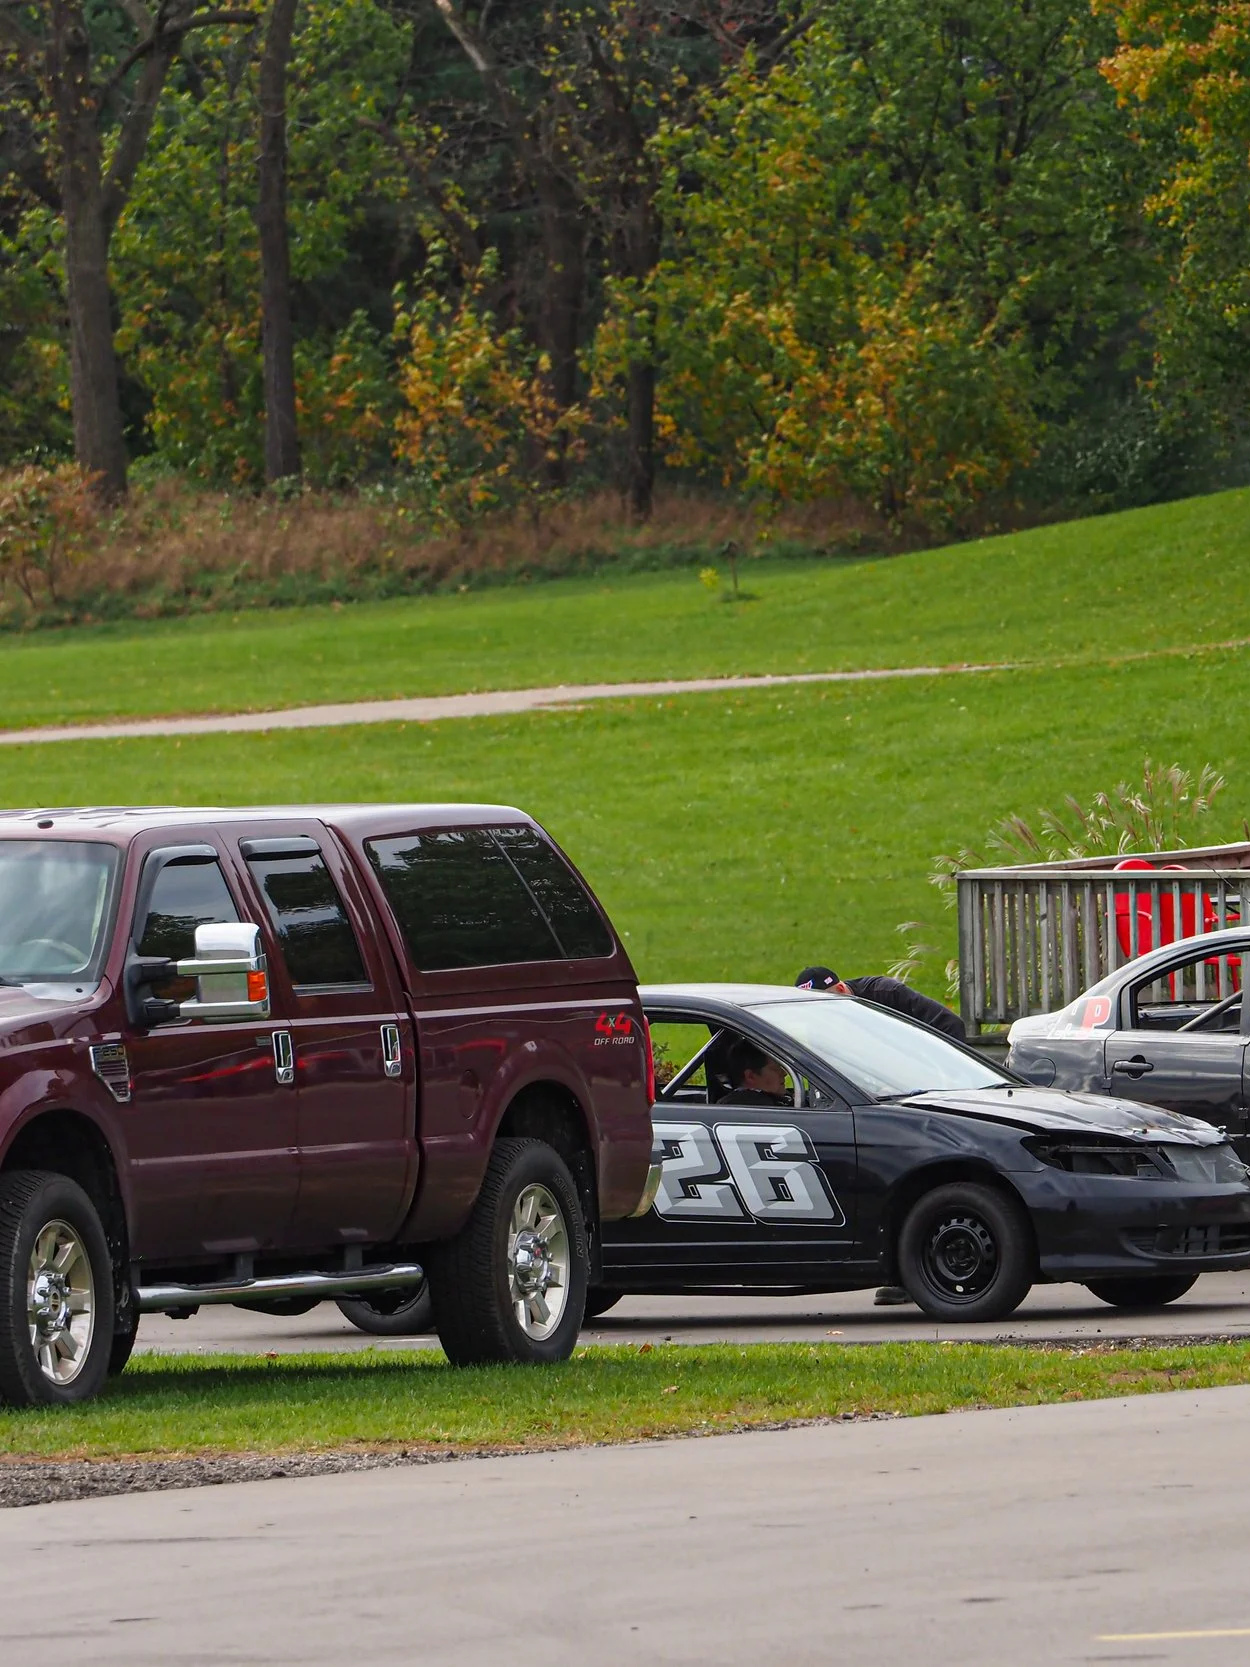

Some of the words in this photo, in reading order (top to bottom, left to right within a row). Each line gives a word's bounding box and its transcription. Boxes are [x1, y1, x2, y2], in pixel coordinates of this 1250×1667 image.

[594, 1037, 610, 1046] OFF
[612, 1036, 635, 1045] ROAD
[651, 1120, 846, 1227] 26
